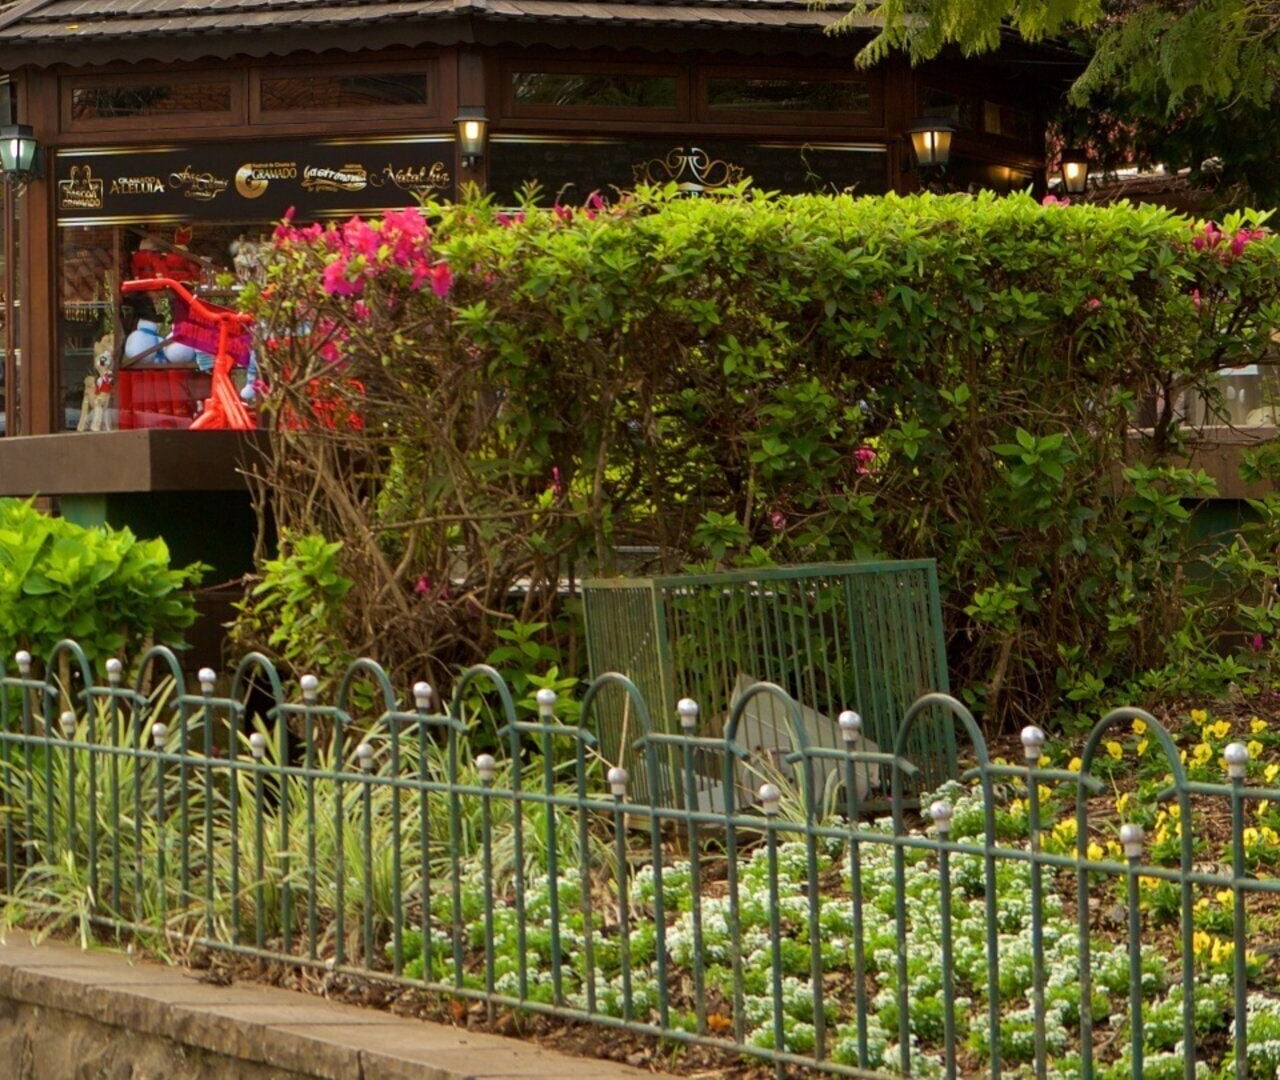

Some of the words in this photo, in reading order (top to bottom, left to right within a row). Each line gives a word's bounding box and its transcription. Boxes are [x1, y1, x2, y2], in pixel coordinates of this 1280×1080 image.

[251, 168, 297, 179] GRAMADO
[117, 176, 155, 184] GRAMADO
[109, 178, 165, 194] ALELUIA
